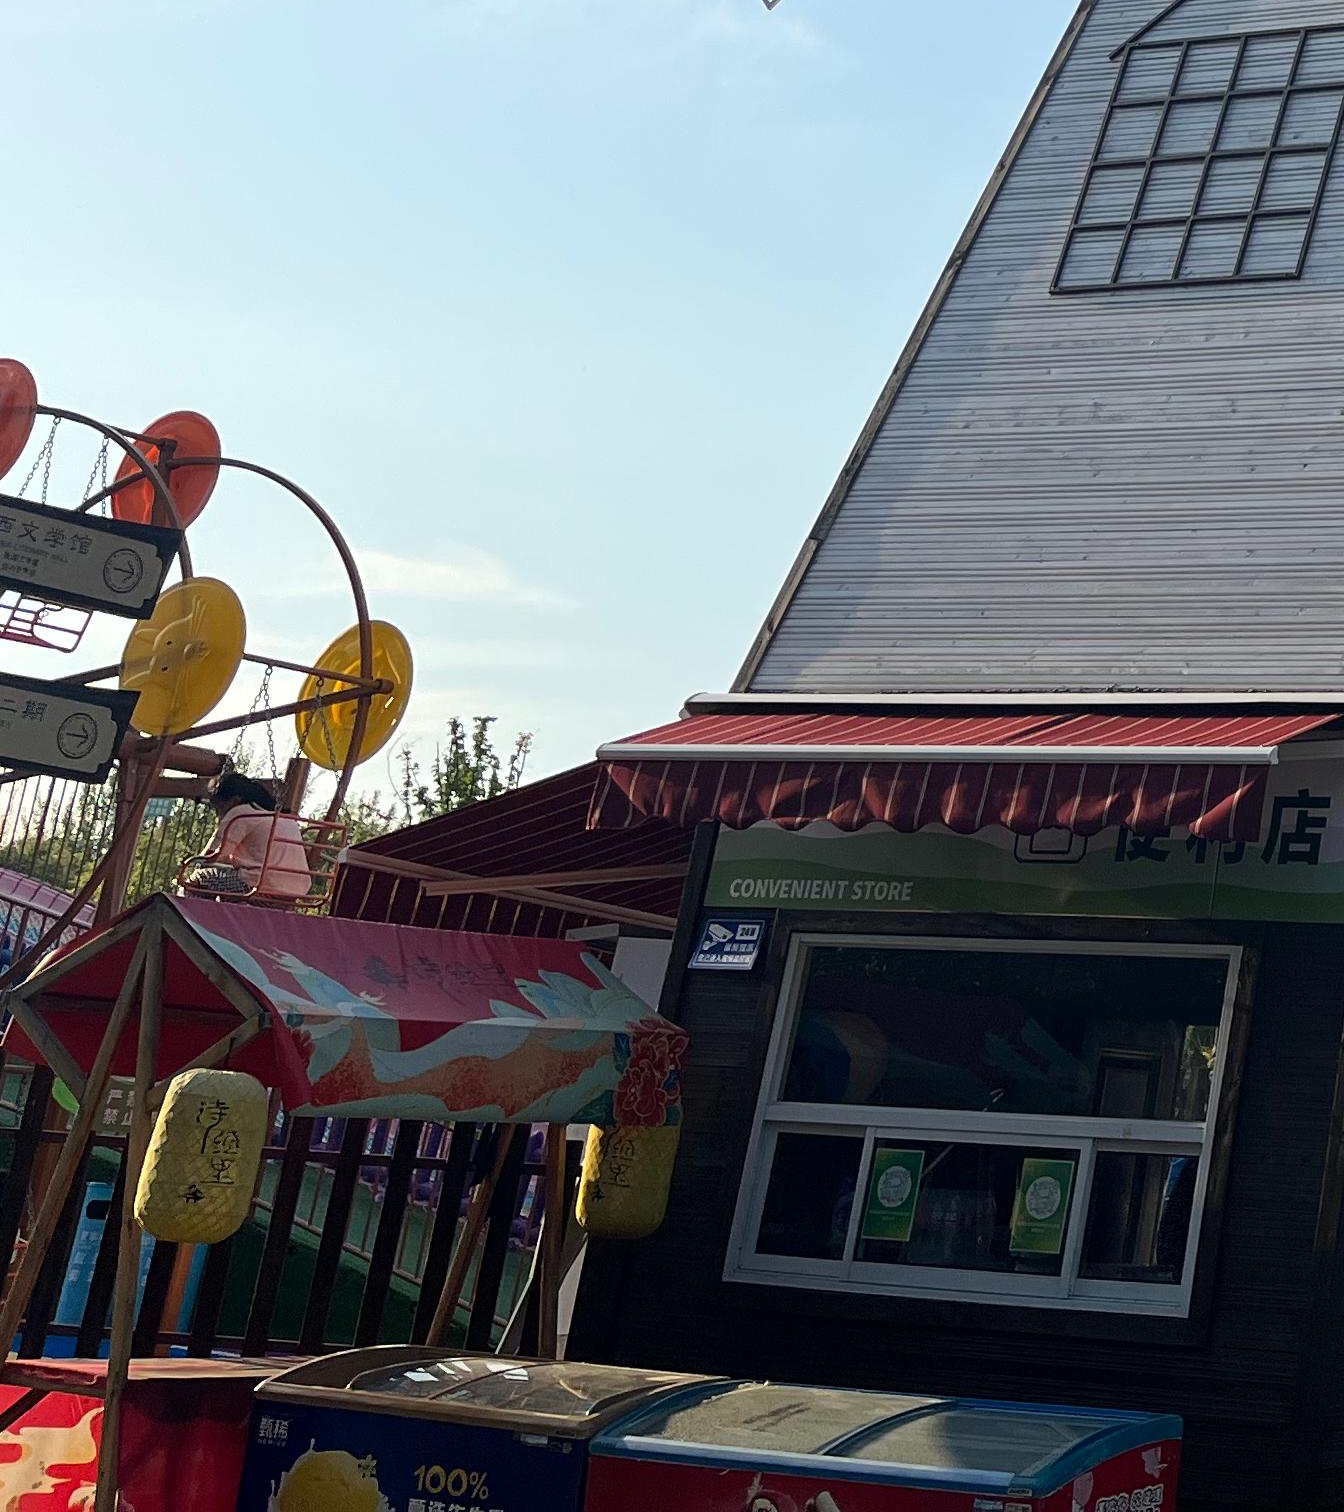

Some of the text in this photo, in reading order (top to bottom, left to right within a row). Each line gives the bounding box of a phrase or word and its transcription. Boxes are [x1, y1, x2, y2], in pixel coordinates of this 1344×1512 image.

[729, 878, 915, 901] CONVENIENT STORE
[413, 1464, 489, 1500] 100%
